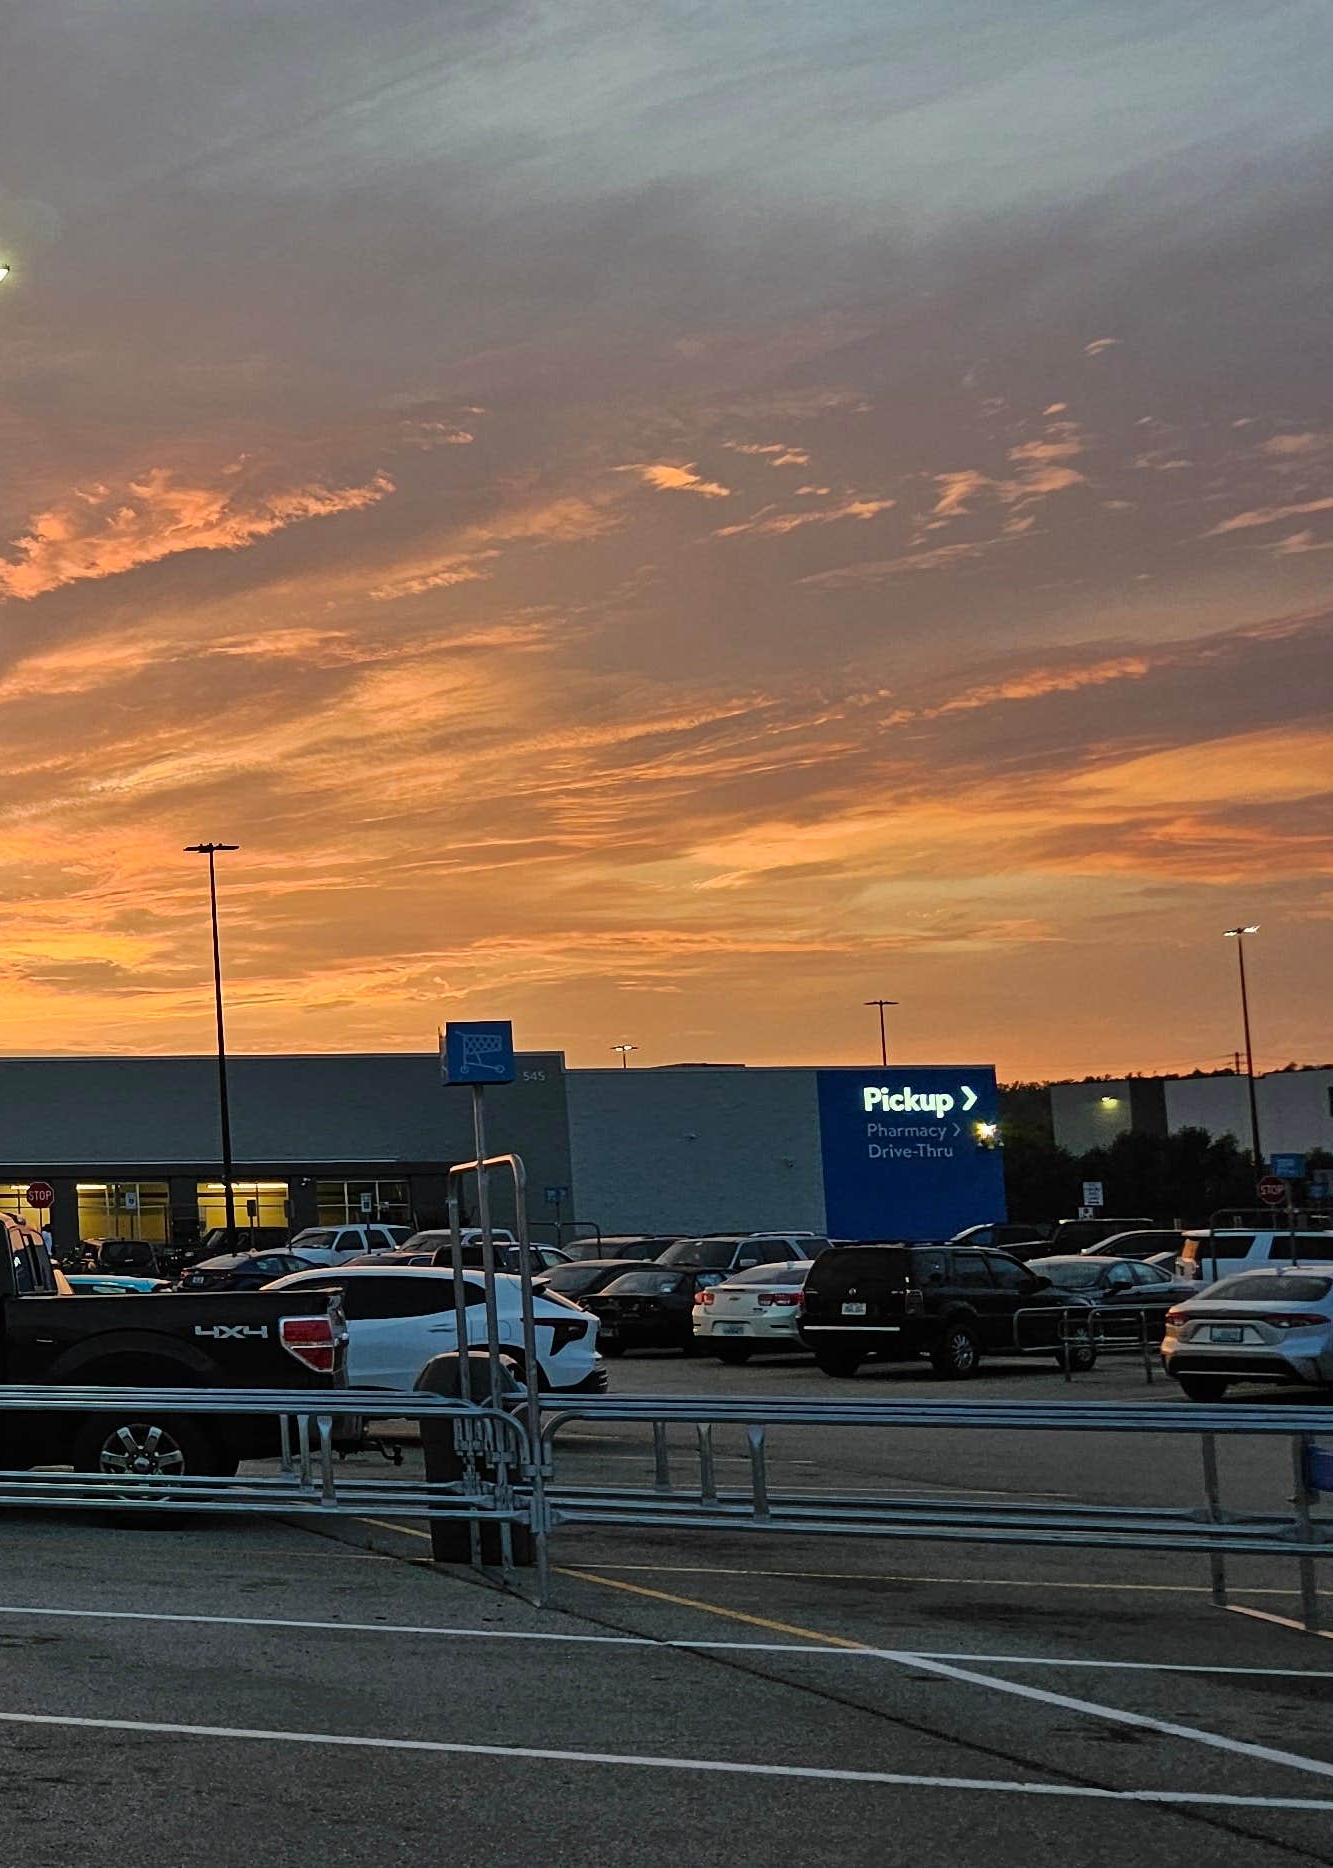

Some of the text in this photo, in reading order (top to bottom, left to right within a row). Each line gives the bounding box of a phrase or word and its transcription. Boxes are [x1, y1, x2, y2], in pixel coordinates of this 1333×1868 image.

[523, 1071, 546, 1081] 545
[864, 1086, 953, 1118] Pickup
[867, 1123, 947, 1142] Pharmacy
[869, 1144, 954, 1159] Drive-Thru
[28, 1189, 52, 1201] STOP
